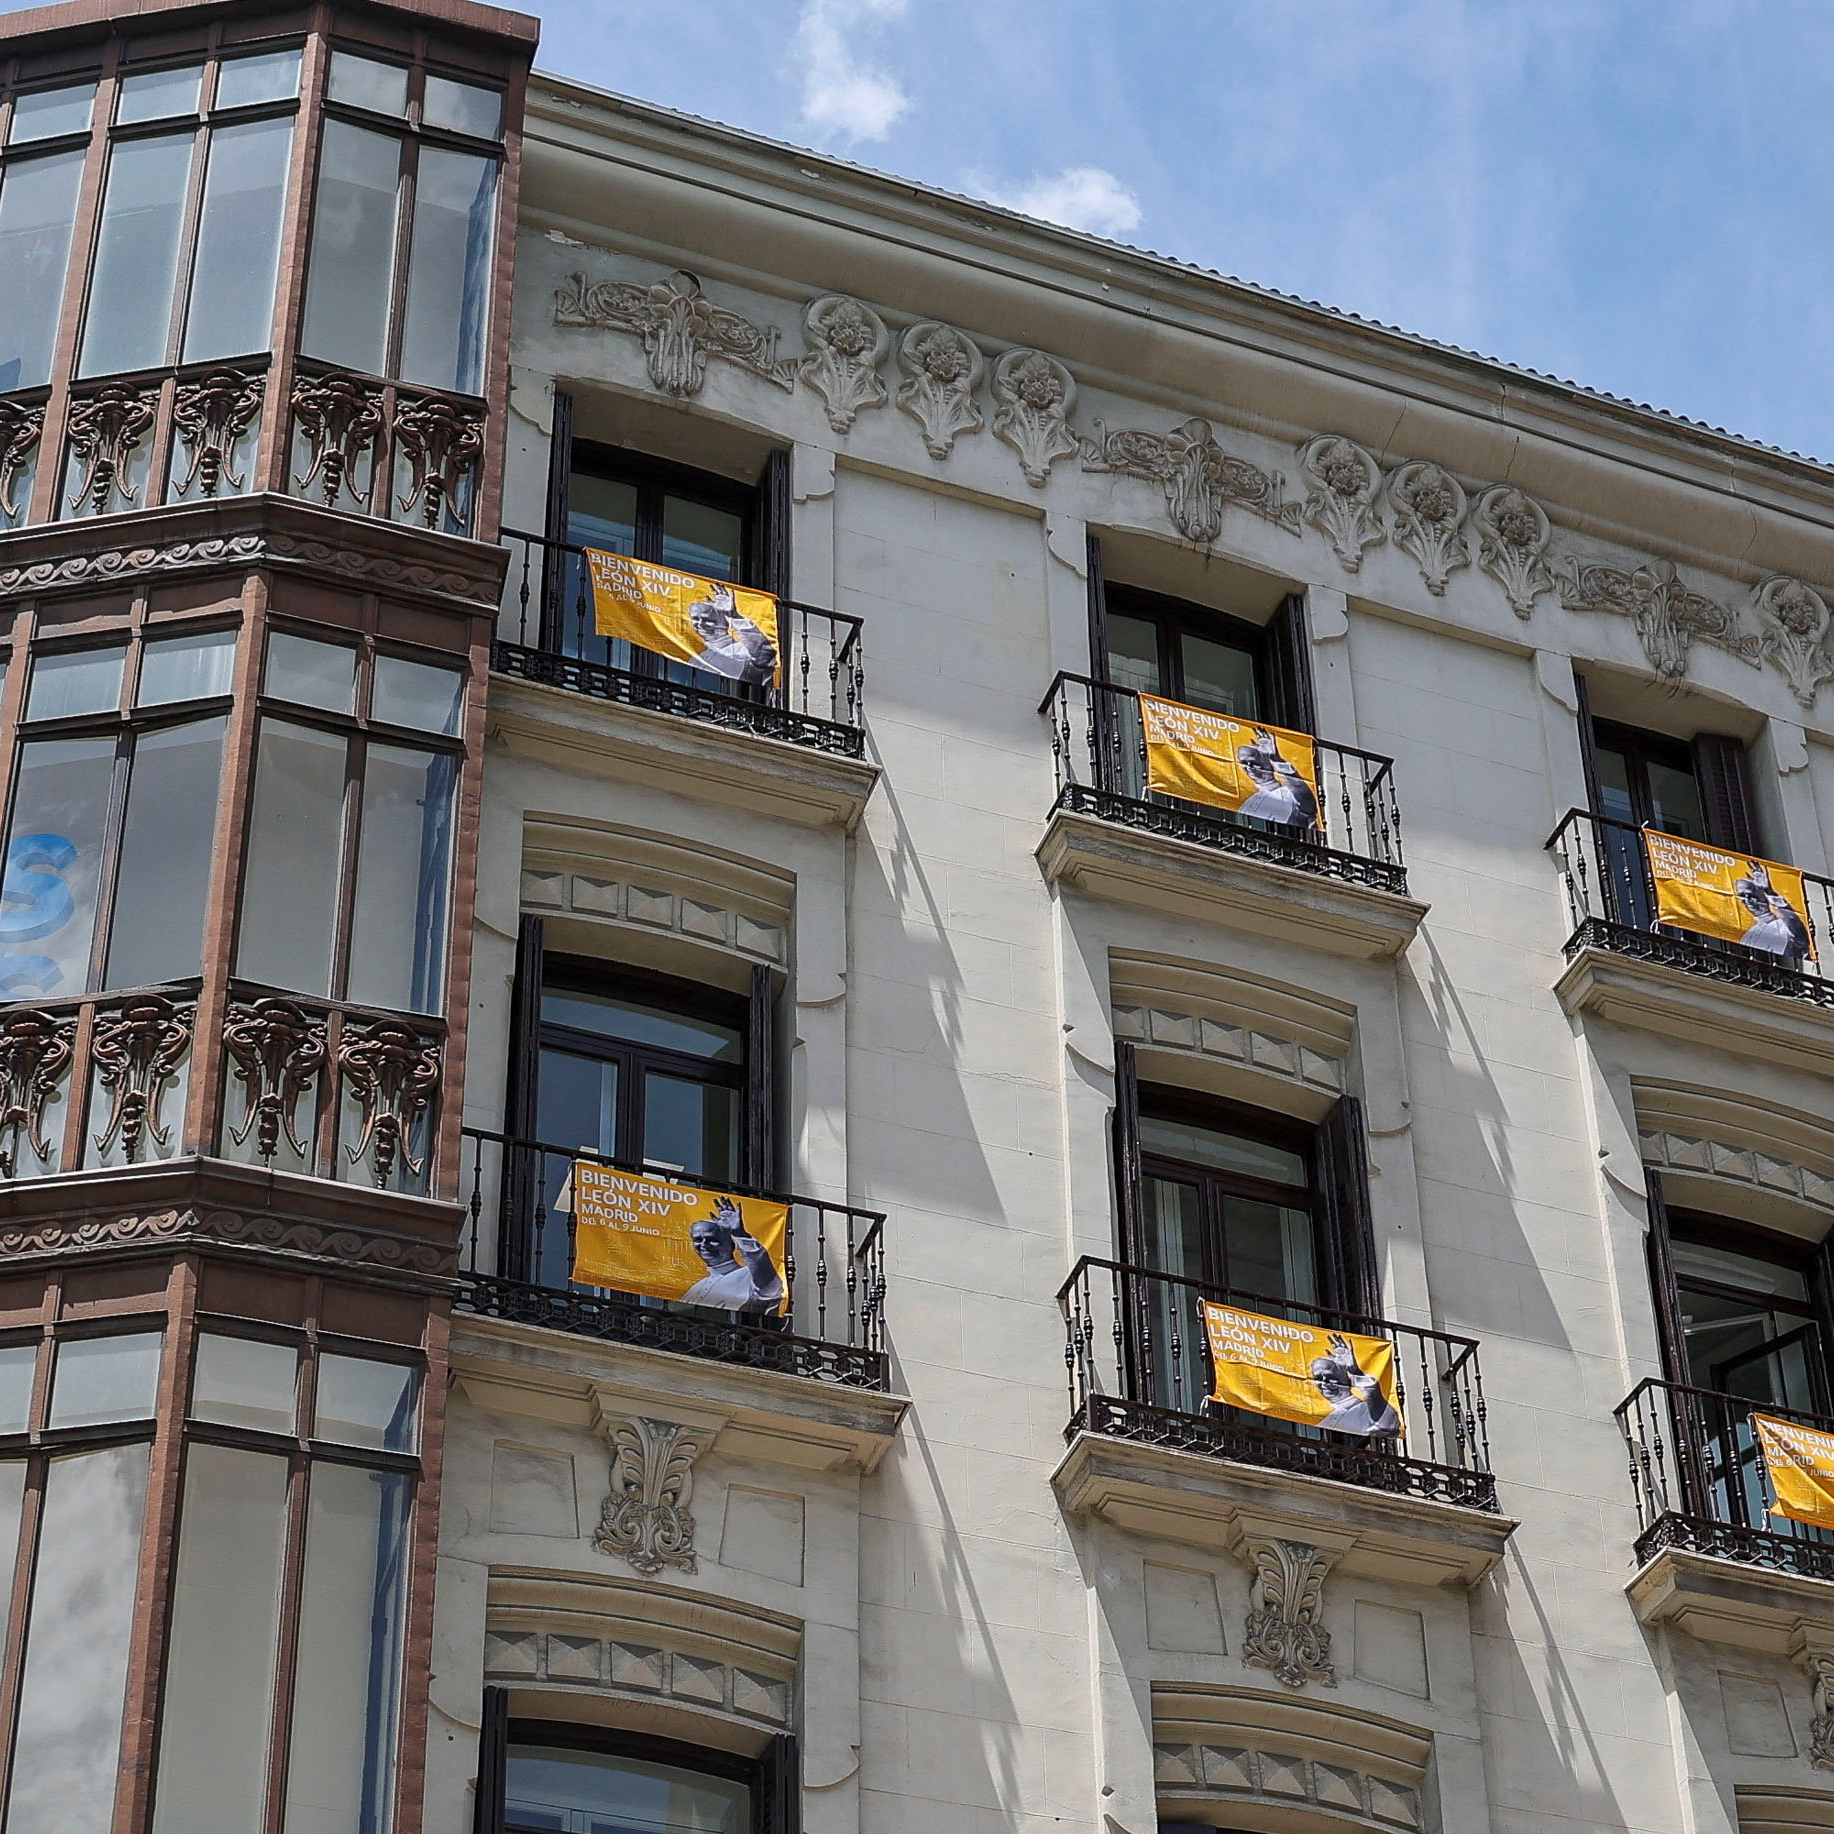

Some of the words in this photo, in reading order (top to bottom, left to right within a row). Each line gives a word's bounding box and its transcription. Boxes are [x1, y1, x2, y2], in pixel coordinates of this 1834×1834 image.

[591, 553, 695, 589] BIENVENIDO
[641, 580, 671, 596] XIV
[1146, 699, 1239, 733] BIENVENIDO
[1149, 710, 1187, 731] LEÓN
[1193, 723, 1219, 740] XIV
[1649, 833, 1736, 867] BIENVENIDO
[1653, 846, 1687, 866] LEÓN
[1694, 859, 1717, 874] XIV
[580, 1170, 698, 1206] BIENVENIDO
[581, 1186, 631, 1209] LEÓN
[637, 1199, 671, 1217] XIV
[581, 1203, 639, 1224] MADRID
[600, 1219, 607, 1228] 6
[608, 1222, 620, 1231] AL
[632, 1226, 661, 1236] JUNIO
[1208, 1310, 1314, 1343] BIENVENIDO
[1210, 1325, 1255, 1348] LEÓN
[1261, 1337, 1291, 1355] XIV
[1213, 1340, 1265, 1360] MADRID
[1767, 1447, 1815, 1467] MARID
